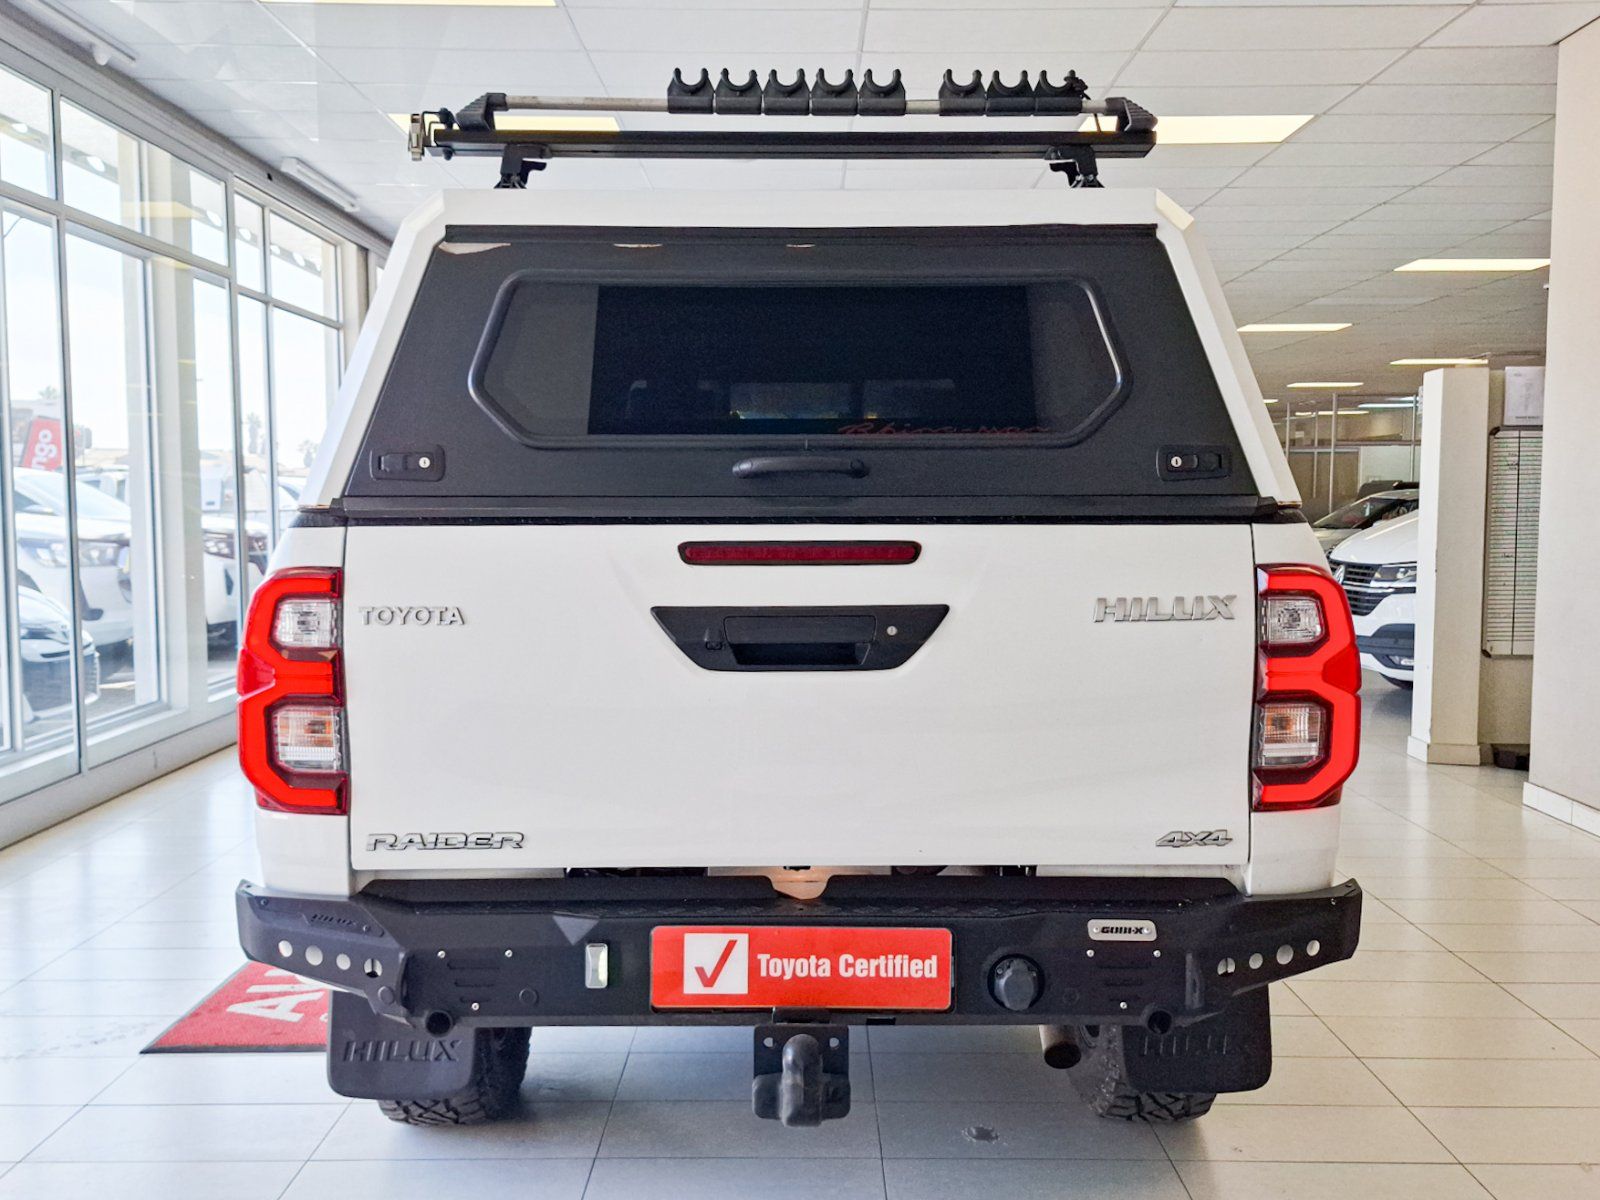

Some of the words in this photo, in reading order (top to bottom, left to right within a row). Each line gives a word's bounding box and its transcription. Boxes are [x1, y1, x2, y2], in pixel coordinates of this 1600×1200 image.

[358, 606, 466, 626] TOYOTA
[1093, 595, 1237, 622] HILUX
[366, 832, 525, 851] RAIDER
[757, 953, 831, 980] Toyota
[838, 953, 938, 978] Certified
[343, 1040, 462, 1062] HILUX
